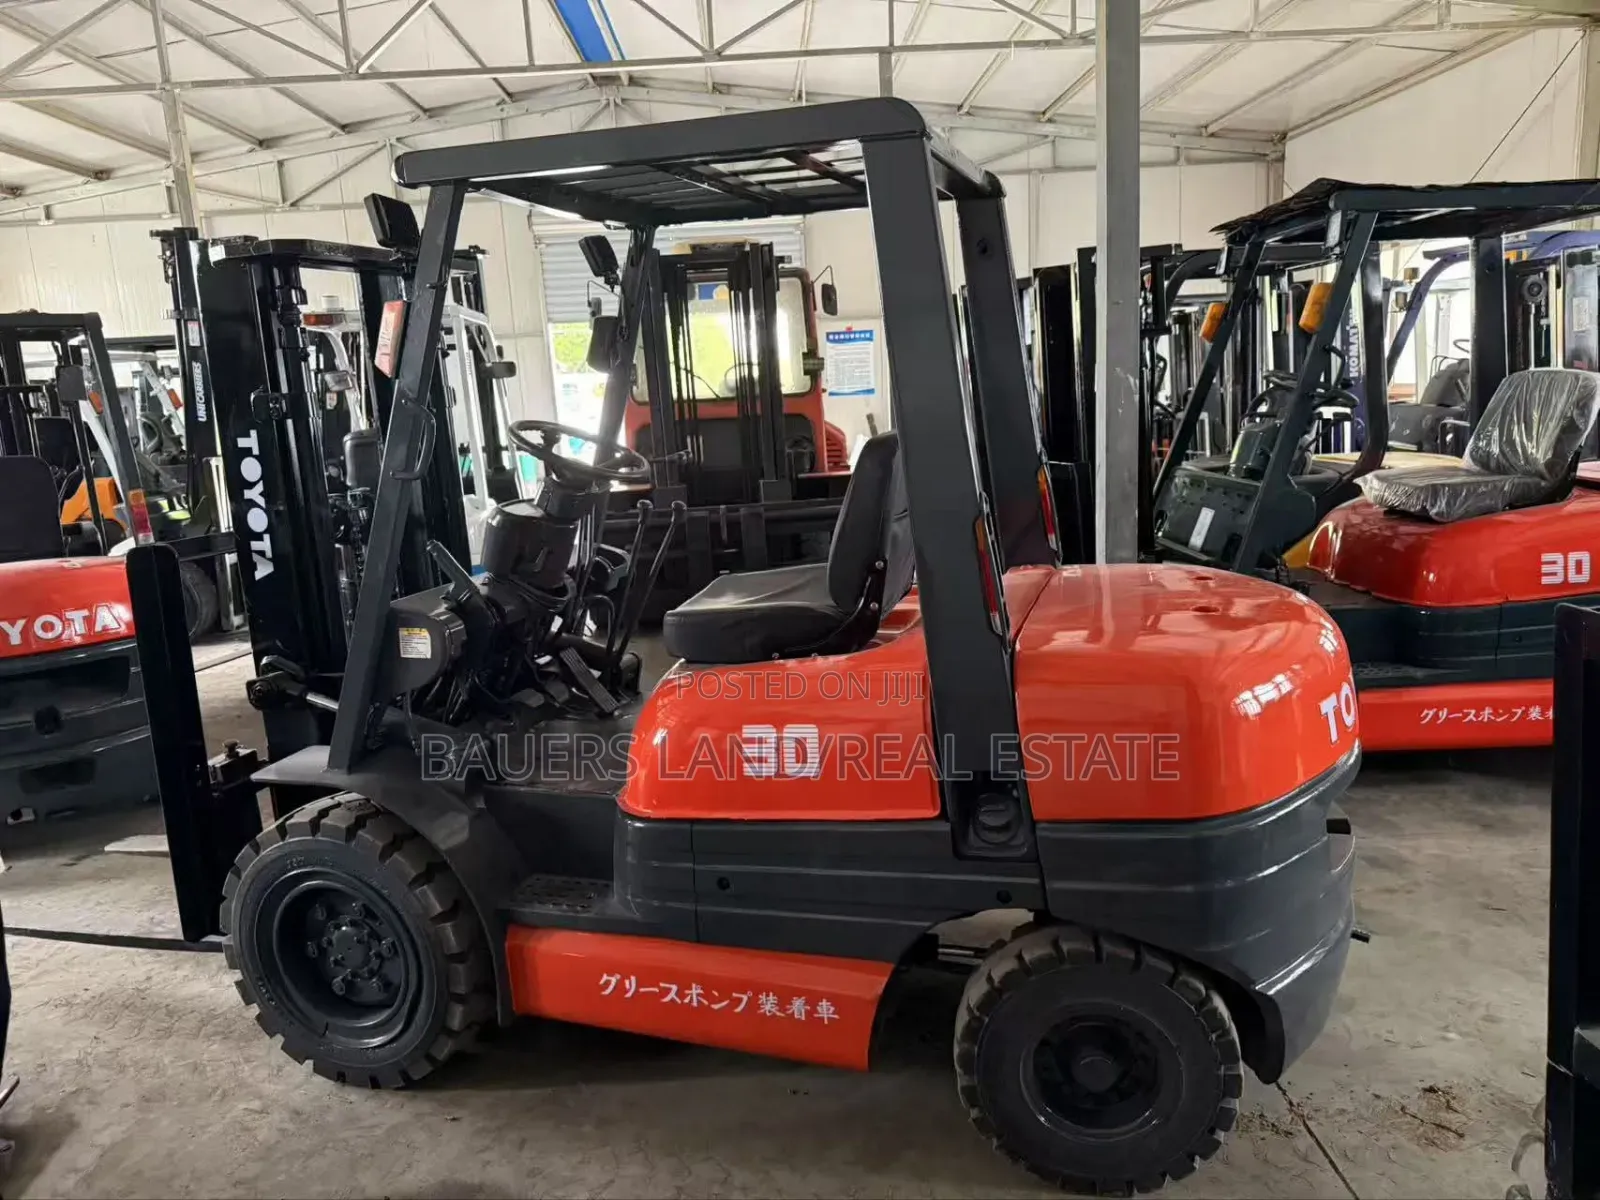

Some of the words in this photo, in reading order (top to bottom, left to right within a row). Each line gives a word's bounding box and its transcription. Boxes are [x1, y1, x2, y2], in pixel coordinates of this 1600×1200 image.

[192, 360, 207, 422] UNICARRIERS
[236, 429, 275, 581] TOYOTA
[1541, 551, 1590, 584] 30
[0, 604, 122, 646] YOTA
[1319, 681, 1356, 745] TO
[742, 724, 820, 777] 30
[599, 973, 840, 1024] グリースポンプ装着車
